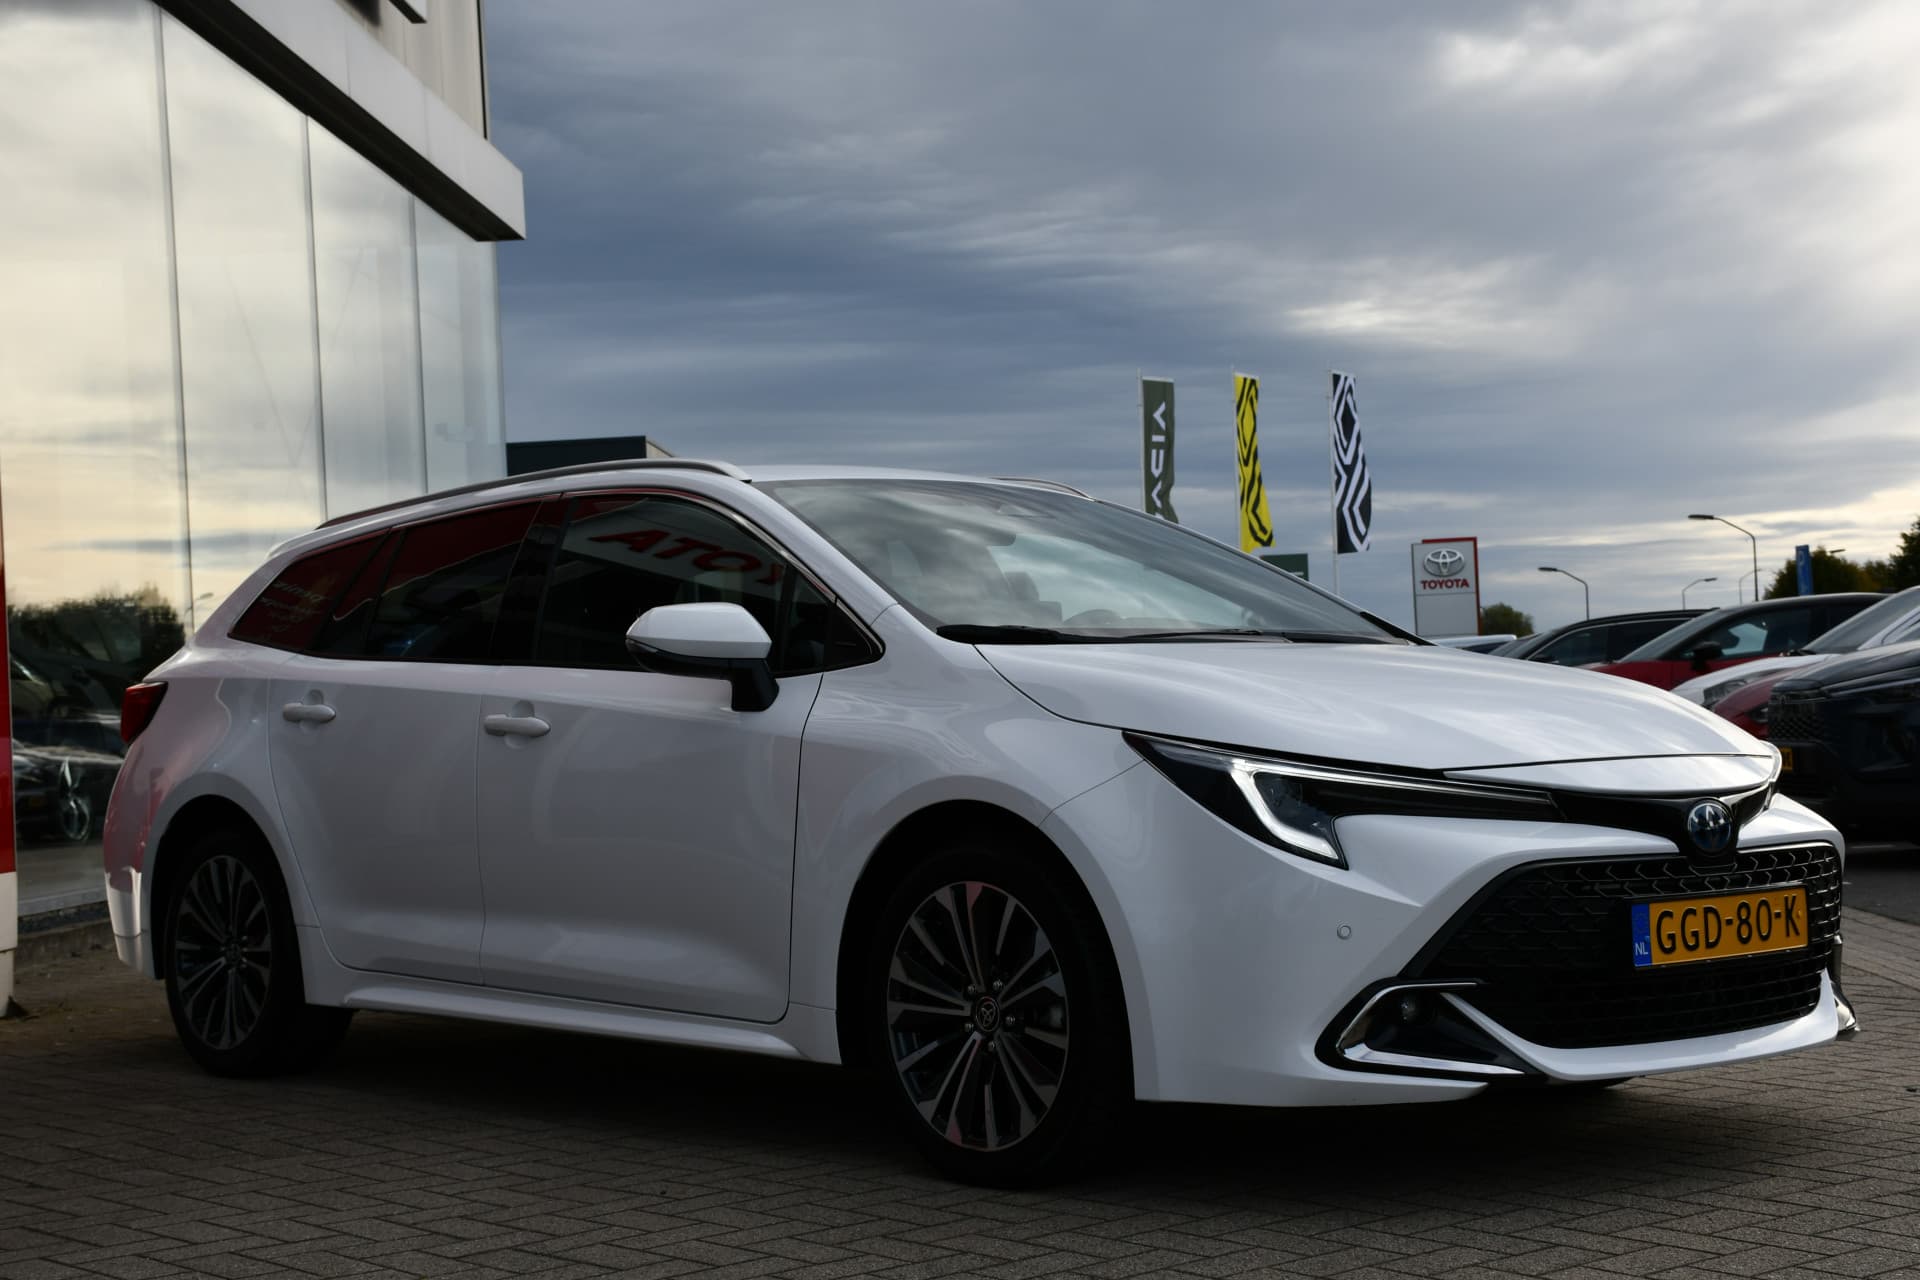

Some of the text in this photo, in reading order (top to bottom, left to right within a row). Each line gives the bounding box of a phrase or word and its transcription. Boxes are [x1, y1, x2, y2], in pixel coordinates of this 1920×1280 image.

[1150, 401, 1167, 520] ACIA
[1421, 578, 1470, 590] TOYOTA
[1655, 895, 1801, 954] GGD-80-K
[1635, 942, 1649, 956] NL
